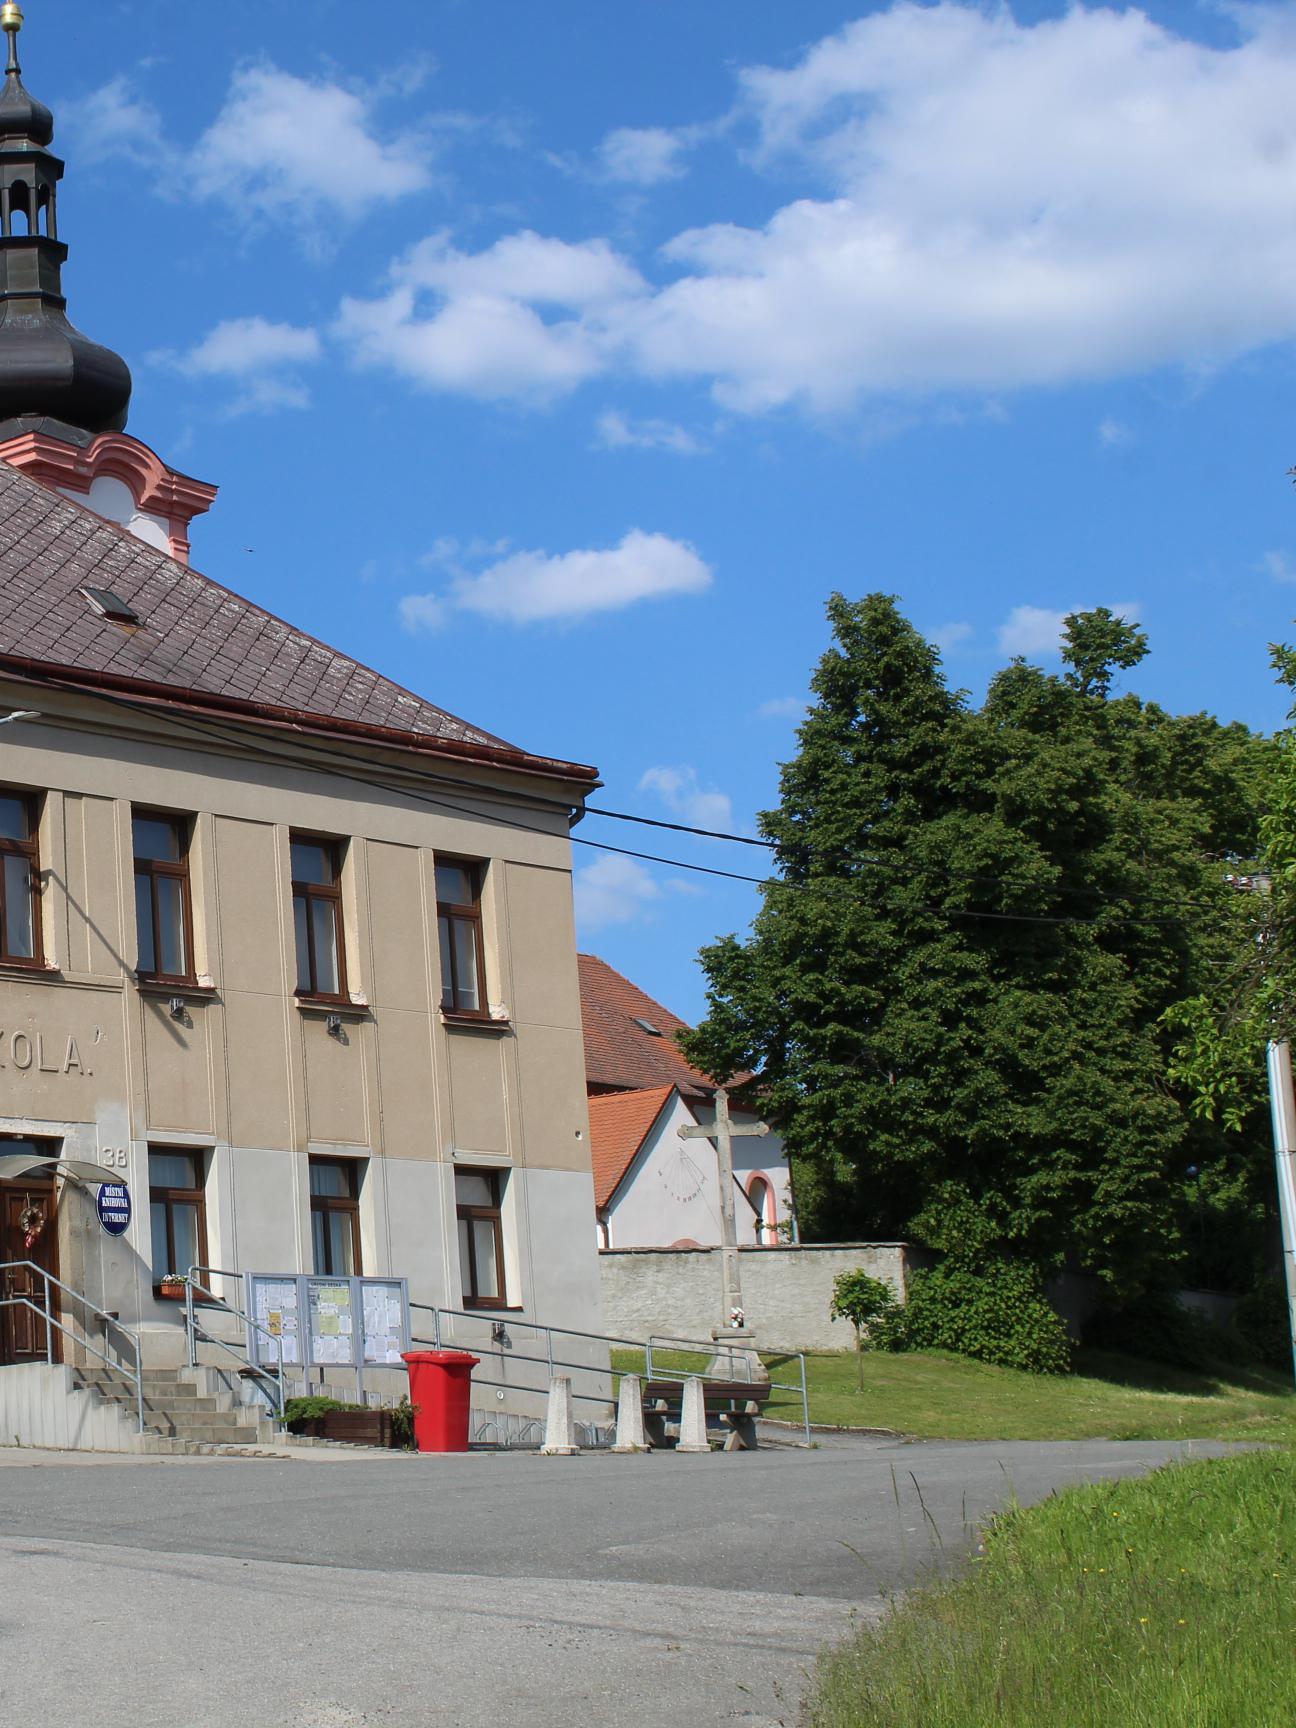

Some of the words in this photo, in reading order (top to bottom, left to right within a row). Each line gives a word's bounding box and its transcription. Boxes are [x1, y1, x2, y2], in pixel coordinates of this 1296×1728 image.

[104, 1184, 124, 1197] MÍSTNÍ
[101, 1197, 128, 1208] KNIHOVNA
[102, 1212, 128, 1223] INTERNET
